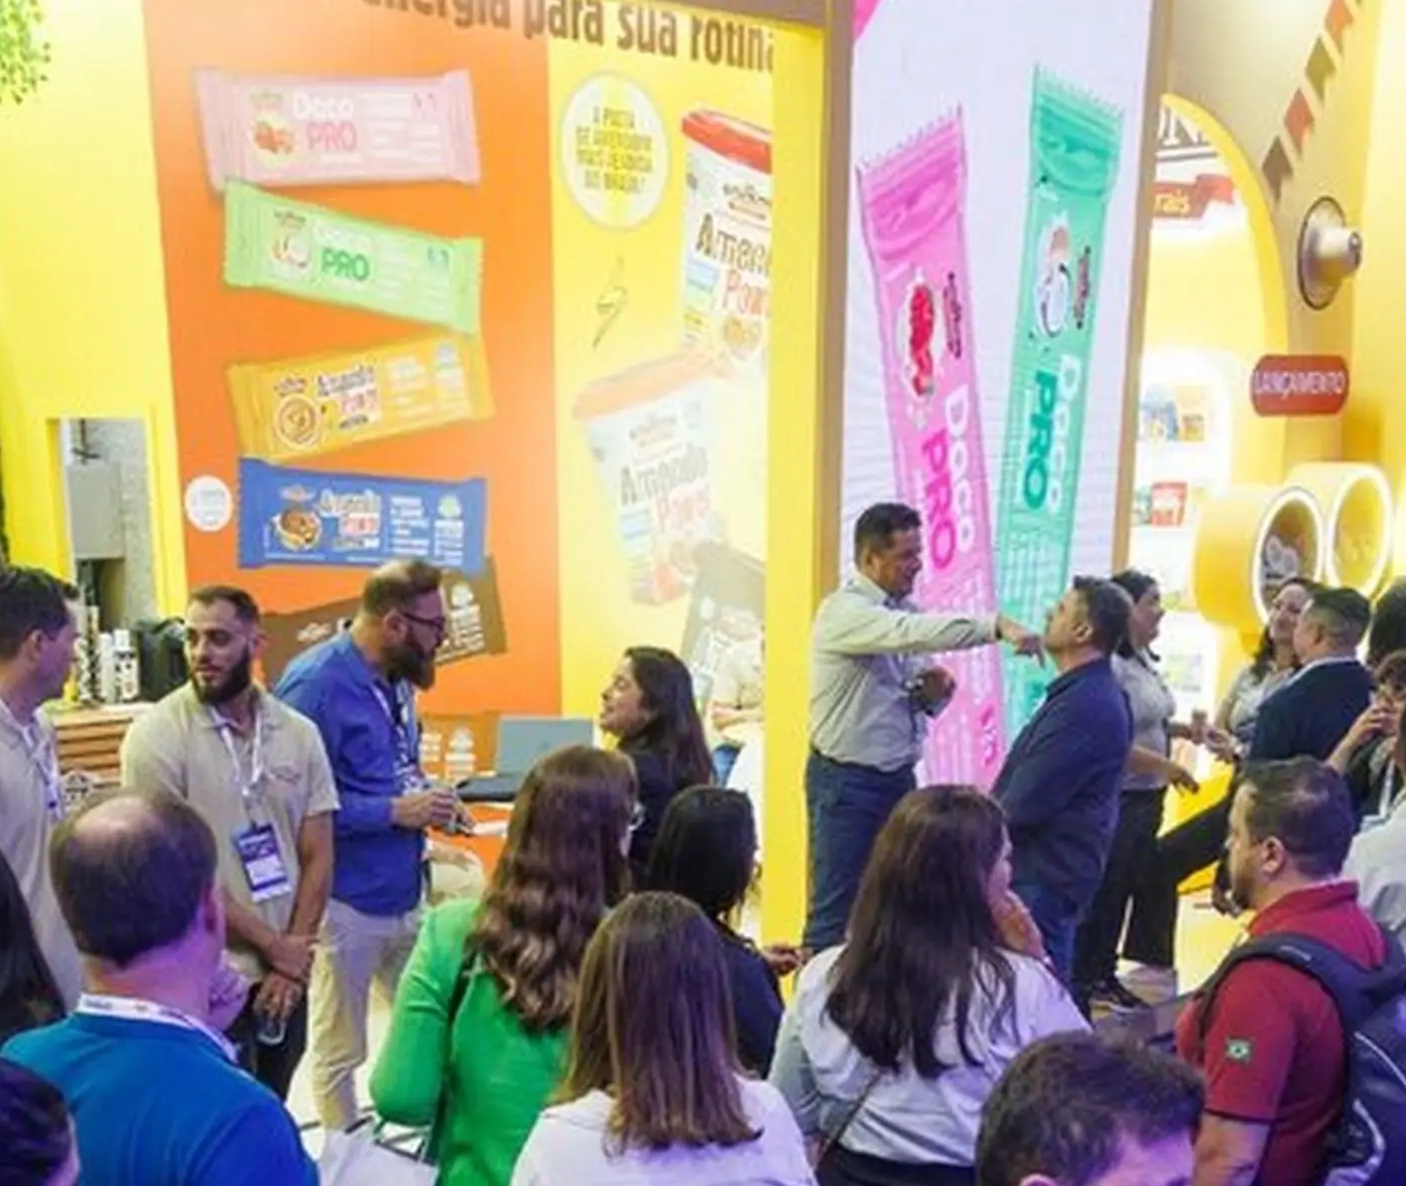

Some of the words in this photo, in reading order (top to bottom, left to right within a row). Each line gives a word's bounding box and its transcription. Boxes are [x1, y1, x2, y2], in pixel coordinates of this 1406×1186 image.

[361, 0, 510, 29] ergia
[524, 0, 604, 46] para
[617, 7, 677, 57] sua
[306, 121, 358, 151] PRO
[321, 248, 370, 281] PRO
[724, 269, 771, 316] Pow
[1255, 371, 1344, 400] LANÇAMENTO
[1023, 369, 1058, 509] PRO
[922, 427, 957, 570] PRO
